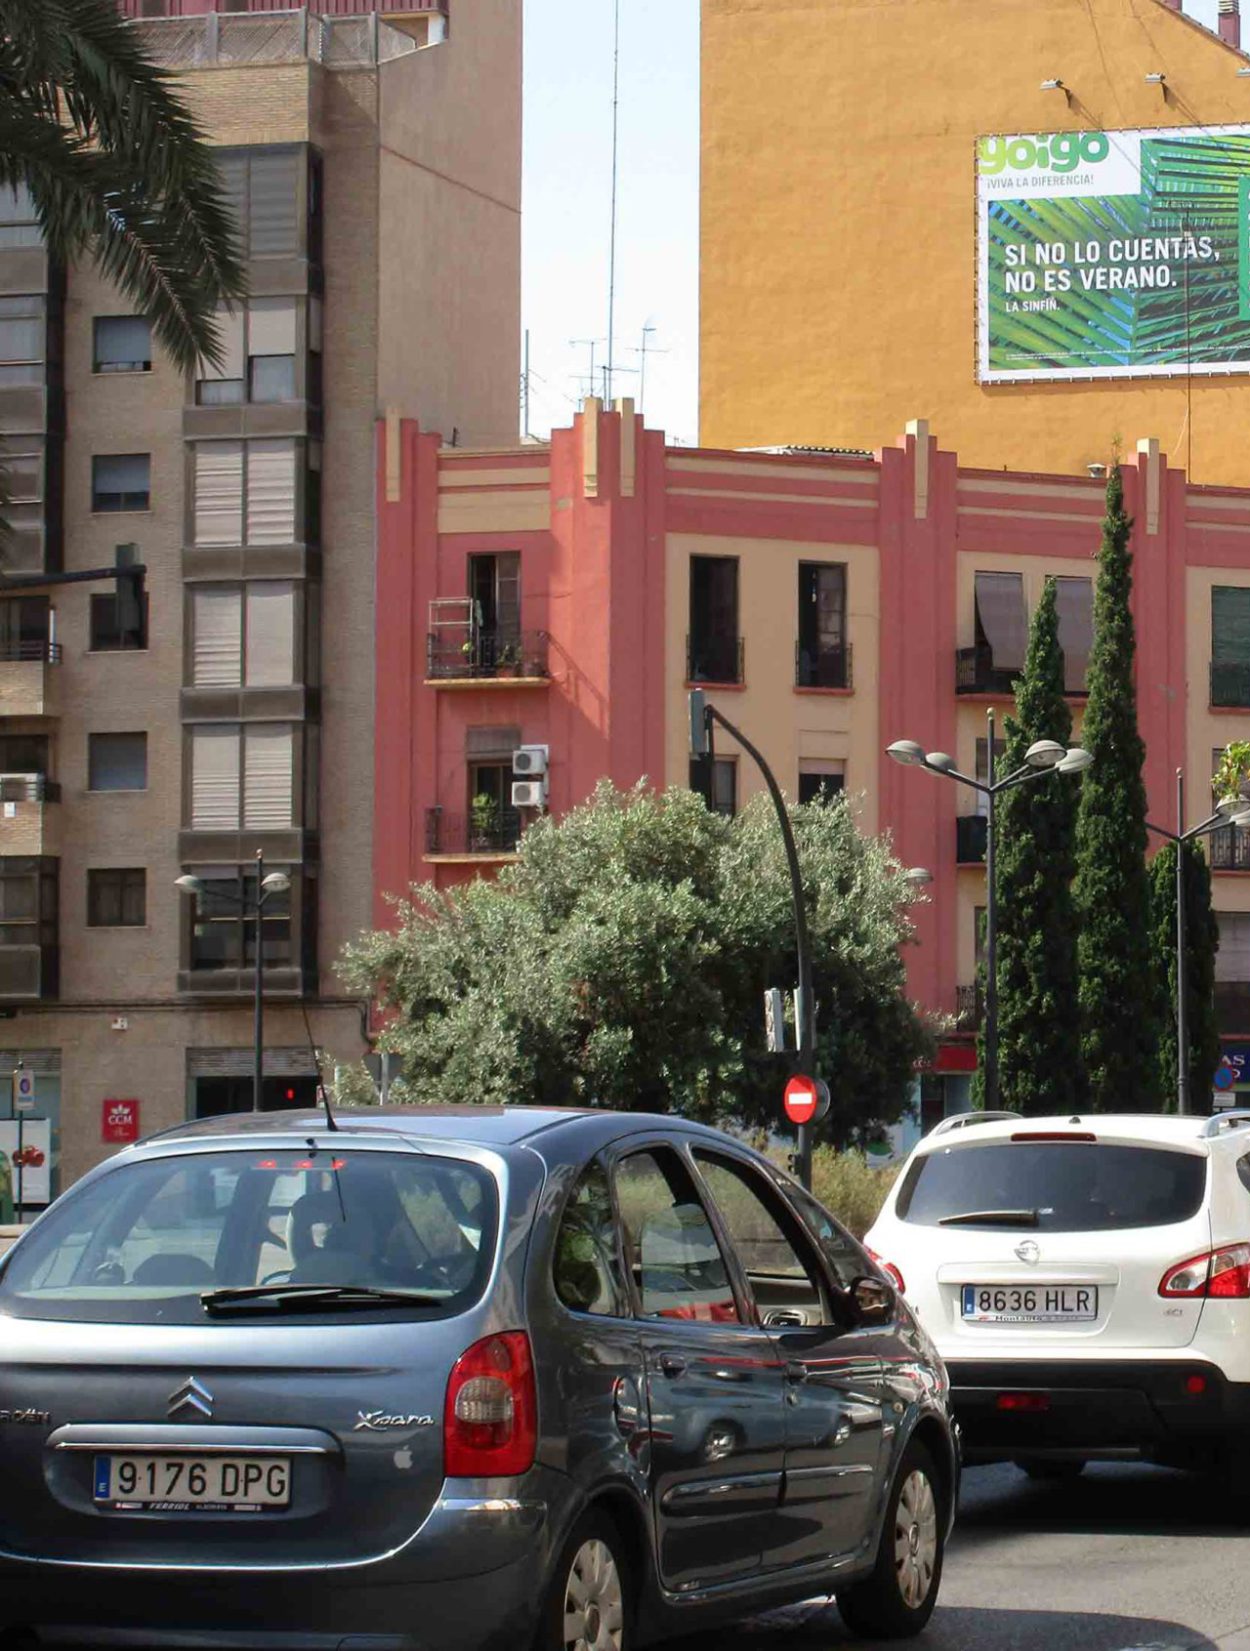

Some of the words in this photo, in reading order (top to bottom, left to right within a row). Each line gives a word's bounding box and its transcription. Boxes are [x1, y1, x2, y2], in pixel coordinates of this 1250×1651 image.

[978, 131, 1110, 175] yoigo
[987, 178, 1014, 189] ¡VIVA
[1016, 176, 1029, 187] LA
[1031, 173, 1094, 186] DIFERENCIA!
[1005, 244, 1026, 266] SI
[1035, 242, 1066, 265] NO
[1074, 240, 1100, 263] LO
[1109, 236, 1220, 262] CUENTAS,
[1005, 271, 1035, 293] NO
[1044, 269, 1072, 292] ES
[1080, 265, 1177, 290] VERANO.
[1005, 301, 1020, 313] LA
[108, 1116, 132, 1124] CCM
[979, 1290, 1036, 1312] 8636
[1045, 1290, 1090, 1312] HLR
[119, 1462, 207, 1495] 9176
[221, 1463, 286, 1498] DPG
